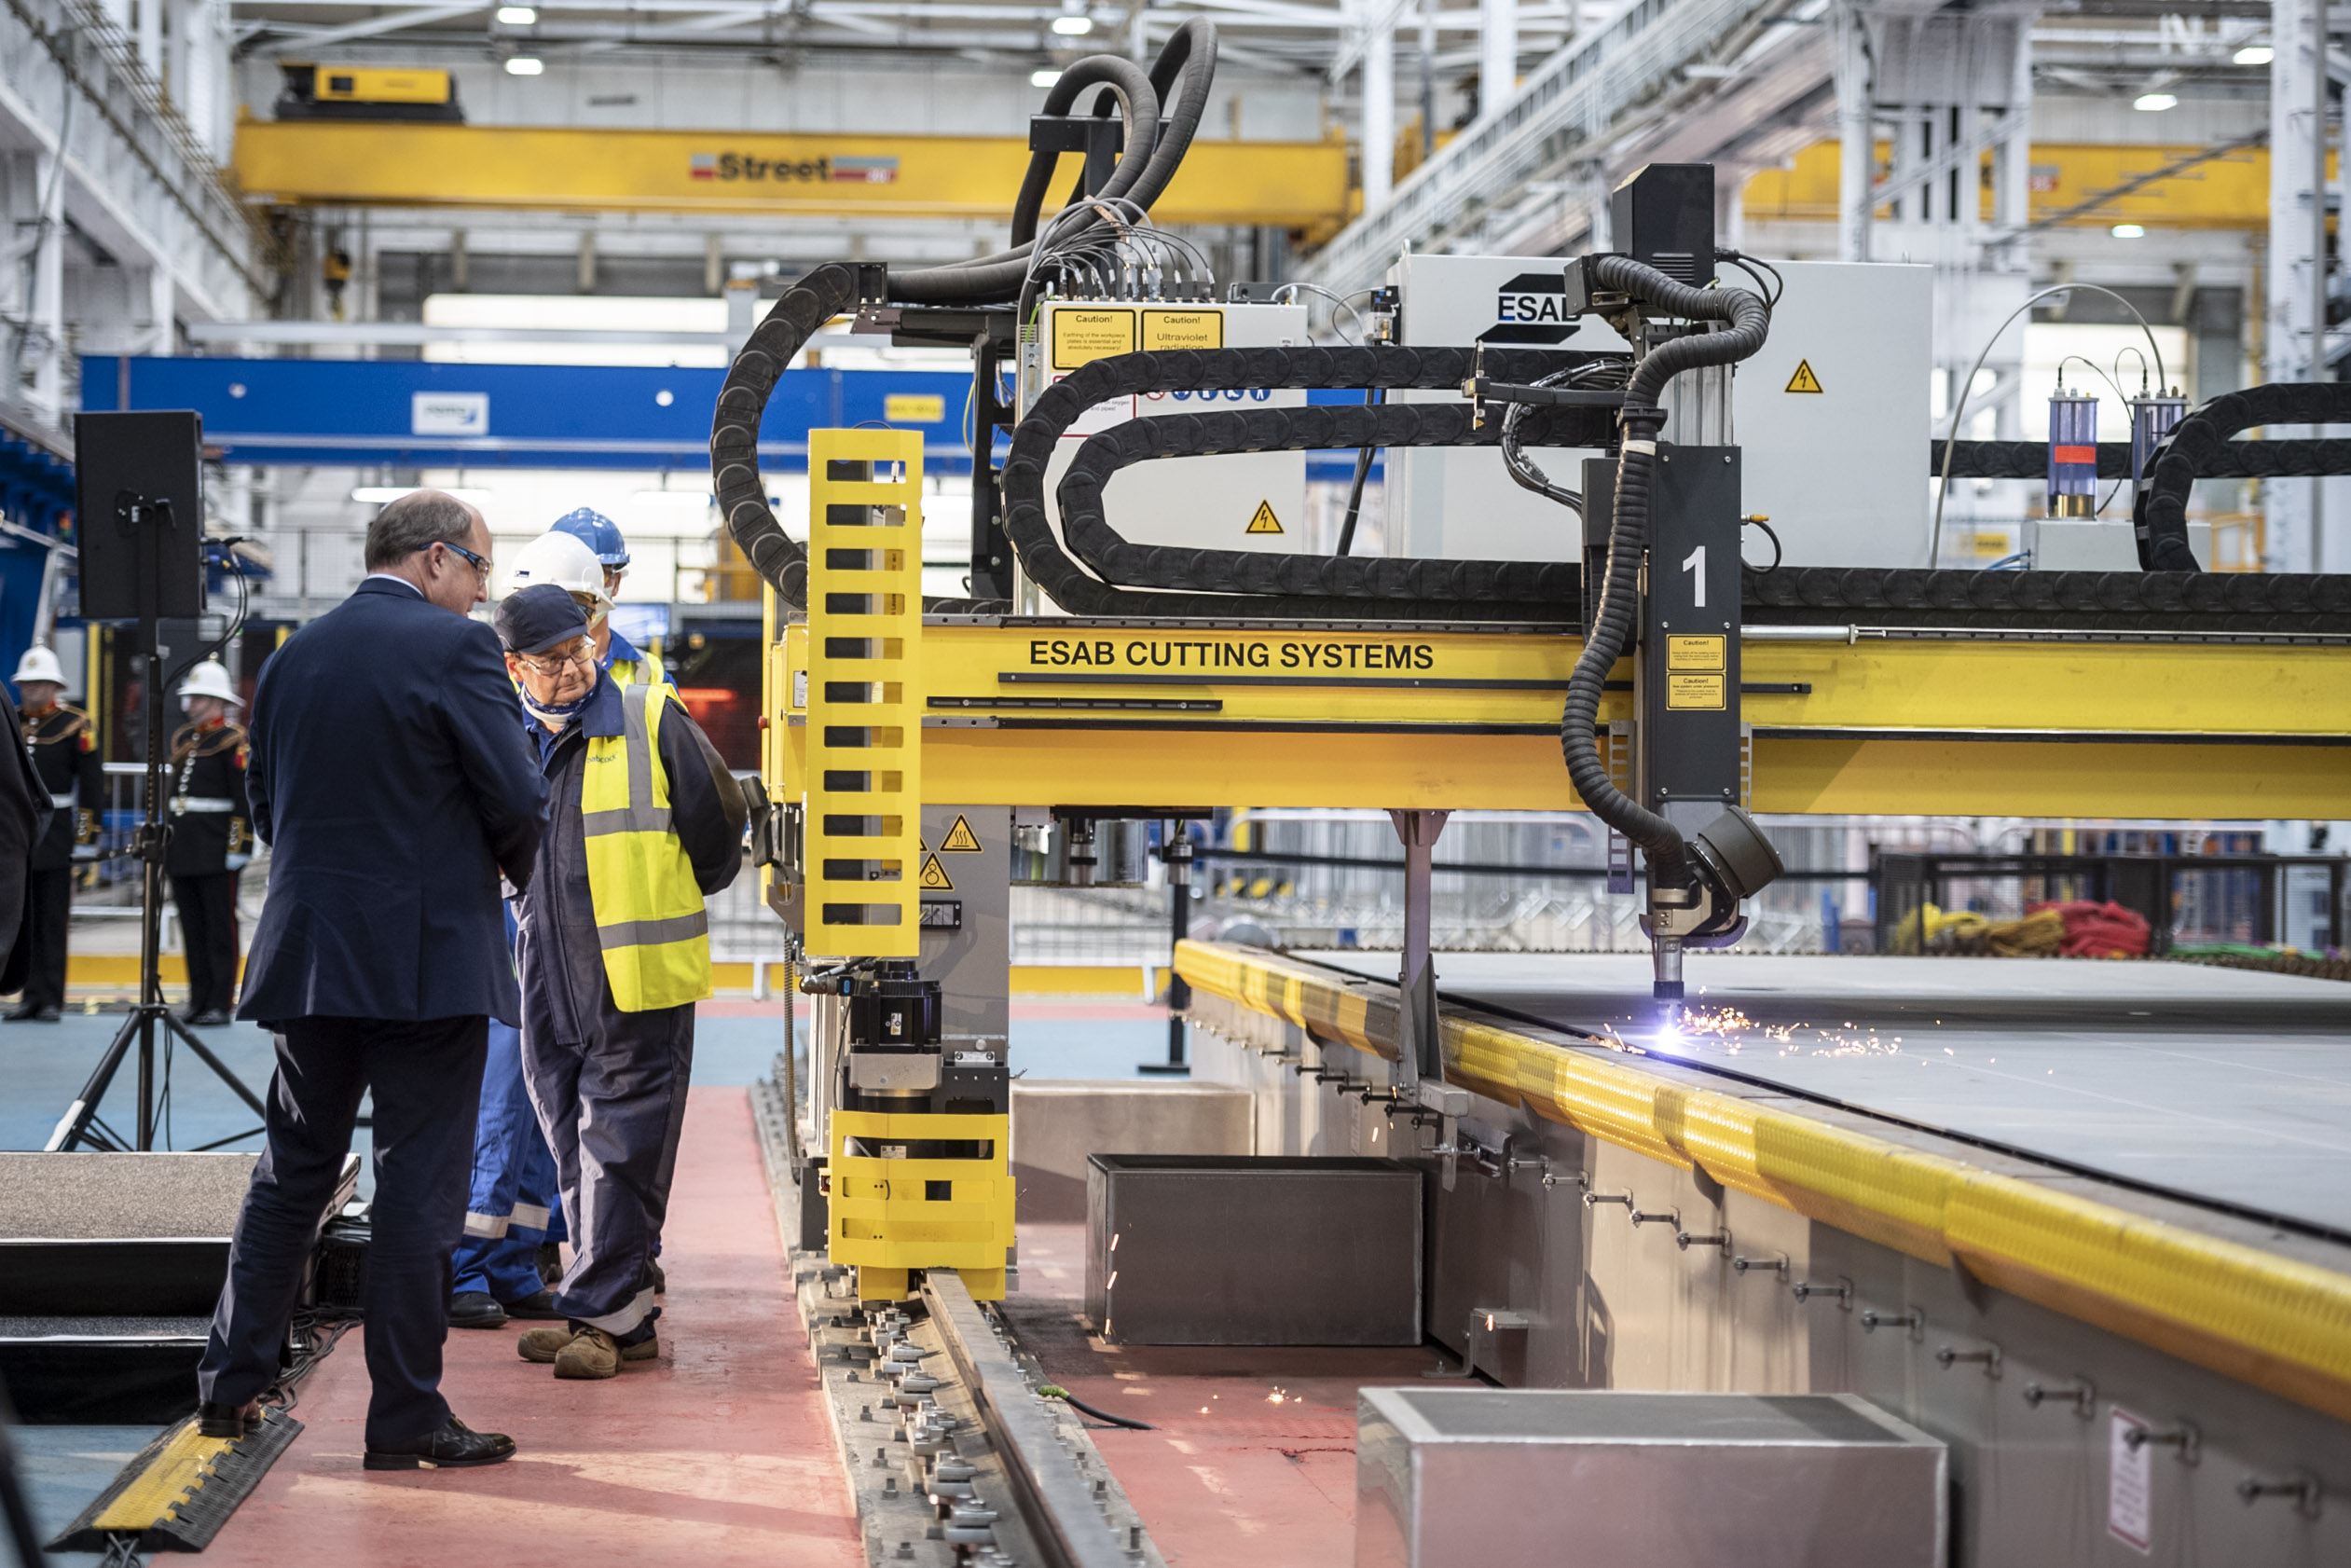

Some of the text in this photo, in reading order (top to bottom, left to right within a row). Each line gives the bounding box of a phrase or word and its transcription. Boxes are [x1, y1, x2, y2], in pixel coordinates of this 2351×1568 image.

[719, 153, 829, 181] Street
[1076, 314, 1113, 323] Caution!
[1163, 315, 1201, 324] Caution!
[1157, 333, 1208, 341] Ultraviolet
[1683, 545, 1705, 607] 1
[1030, 640, 1434, 669] ESAB CUTTING SYSTEMS
